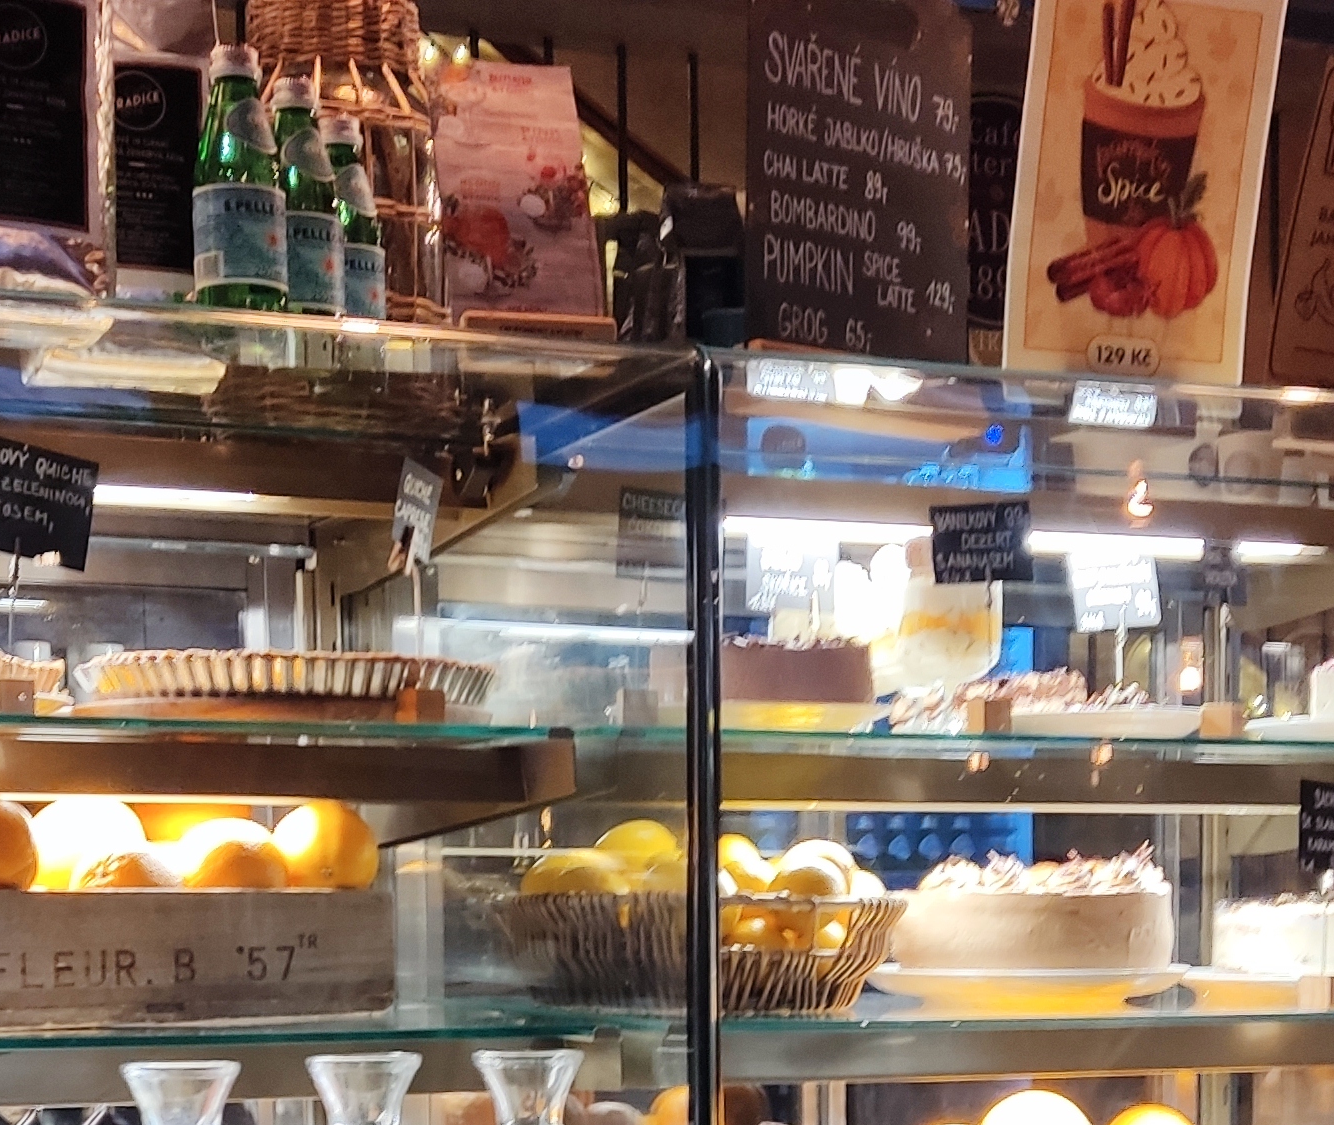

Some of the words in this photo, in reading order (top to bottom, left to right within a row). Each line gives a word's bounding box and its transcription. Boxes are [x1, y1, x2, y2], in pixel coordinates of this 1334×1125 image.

[764, 30, 863, 106] SVAŘENÉ
[874, 56, 922, 123] VÍNO
[116, 91, 161, 109] RADICE
[768, 101, 817, 141] HORKÉ
[764, 150, 797, 181] CHAI
[802, 156, 849, 190] LATTE
[1097, 161, 1166, 208] Spice
[770, 190, 876, 243] BOMBARDINO
[763, 234, 854, 295] PUMPKIN
[863, 251, 902, 283] SPICE
[877, 284, 916, 314] LATTE
[778, 302, 828, 344] GROG
[1096, 346, 1125, 366] 129
[1131, 346, 1152, 367] Kč
[35, 457, 94, 486] QUICHE
[174, 948, 196, 984] B
